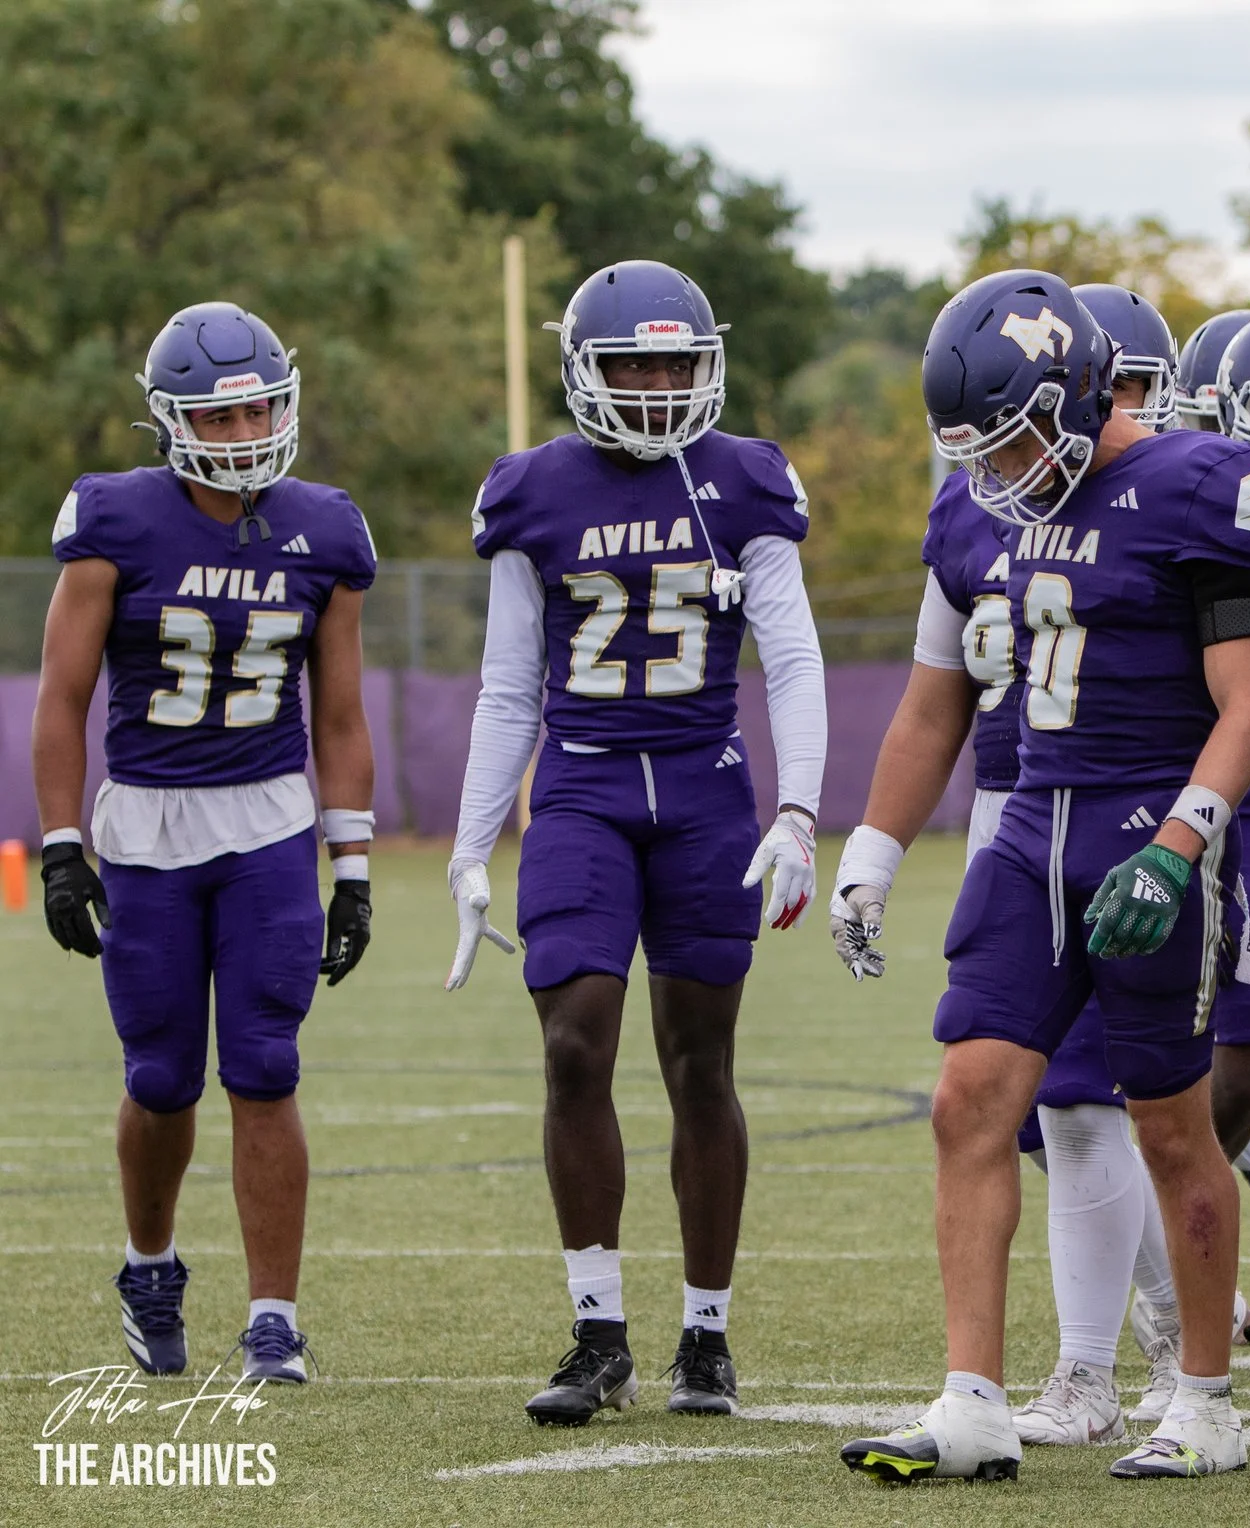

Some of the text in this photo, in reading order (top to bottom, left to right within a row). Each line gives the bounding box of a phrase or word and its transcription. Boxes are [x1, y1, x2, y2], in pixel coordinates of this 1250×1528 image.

[648, 324, 680, 333] Riddell
[220, 377, 257, 390] Riddell
[578, 517, 693, 560] AVILA
[1015, 524, 1100, 564] AVILA
[176, 565, 286, 602] AVILA
[562, 559, 713, 698] 25
[147, 605, 304, 728] 35
[1134, 867, 1171, 904] adidas
